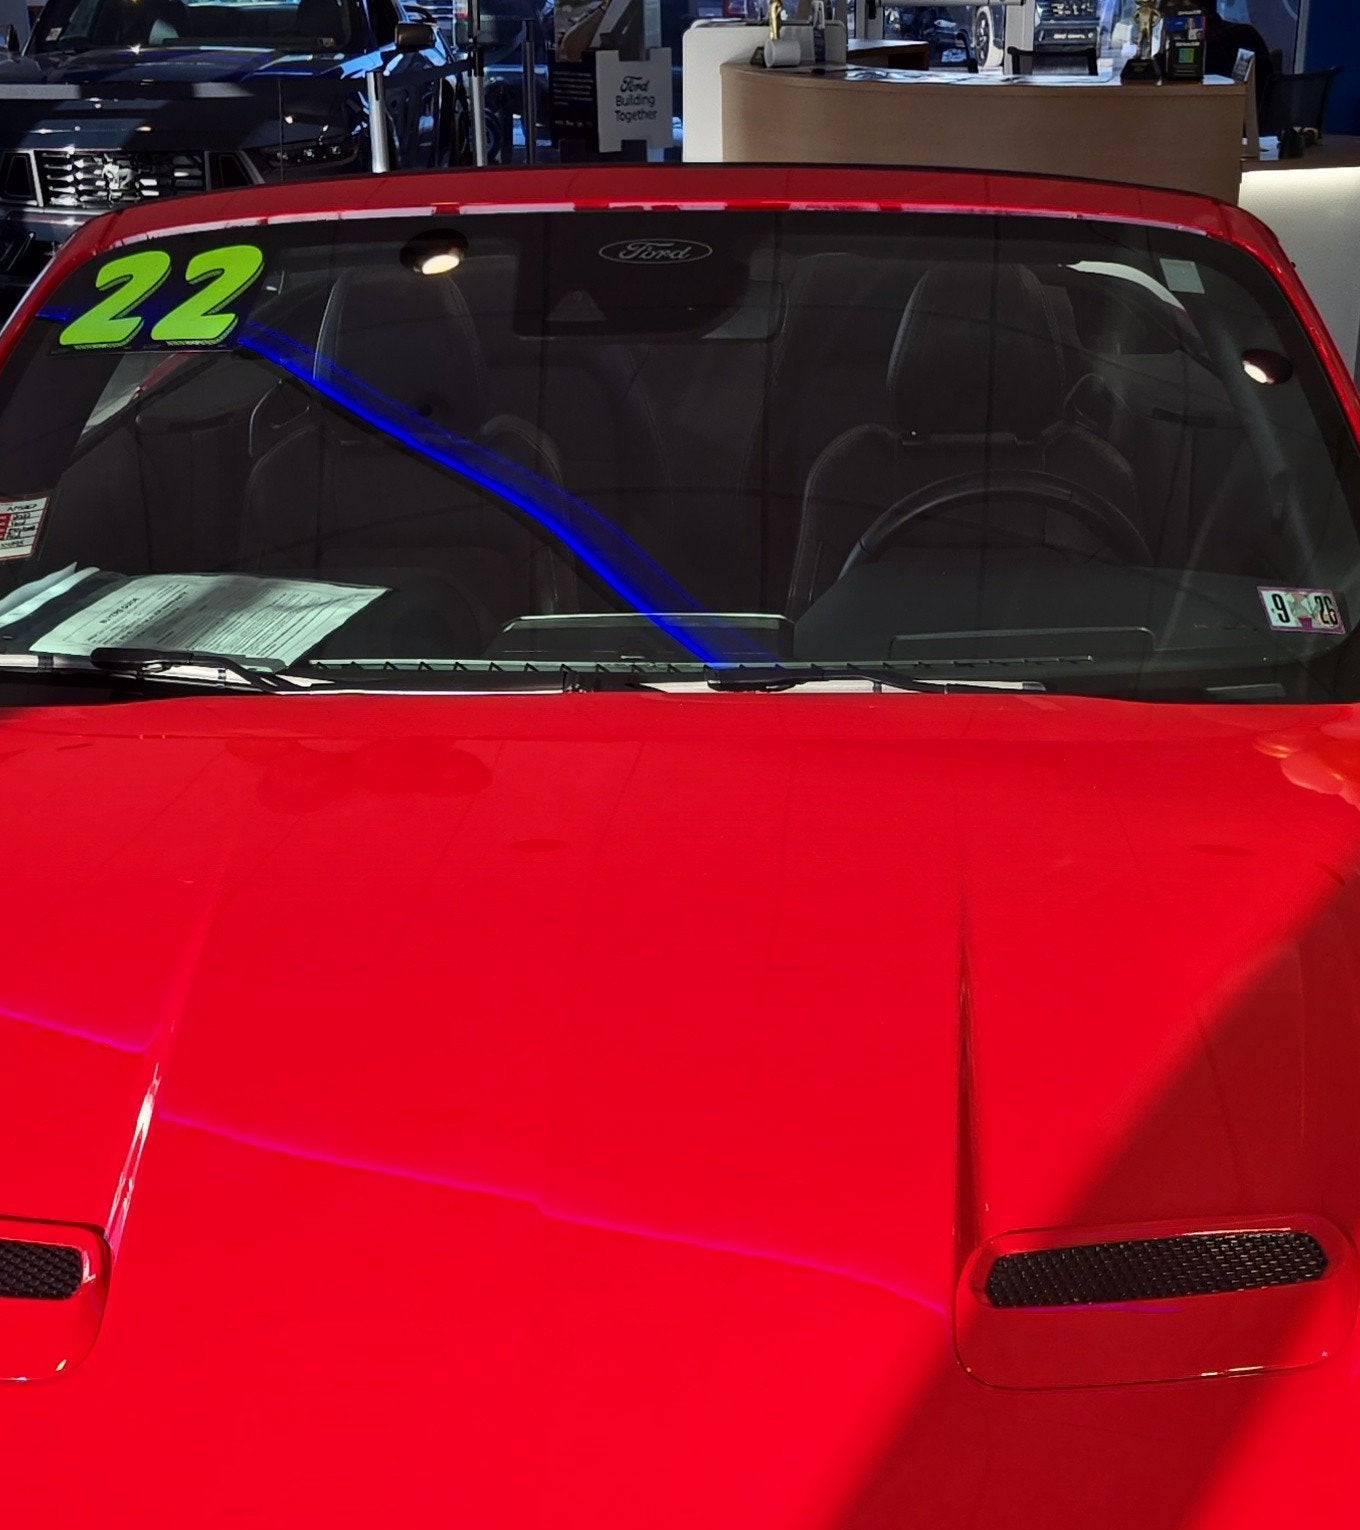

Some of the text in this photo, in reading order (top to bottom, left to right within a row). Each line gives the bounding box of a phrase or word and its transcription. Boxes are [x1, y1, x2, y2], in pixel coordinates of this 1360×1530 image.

[620, 75, 650, 93] Ford
[615, 94, 656, 108] Building
[615, 109, 658, 123] Together
[619, 242, 692, 260] Ford
[59, 245, 265, 350] 22
[1271, 593, 1339, 626] 9 26
